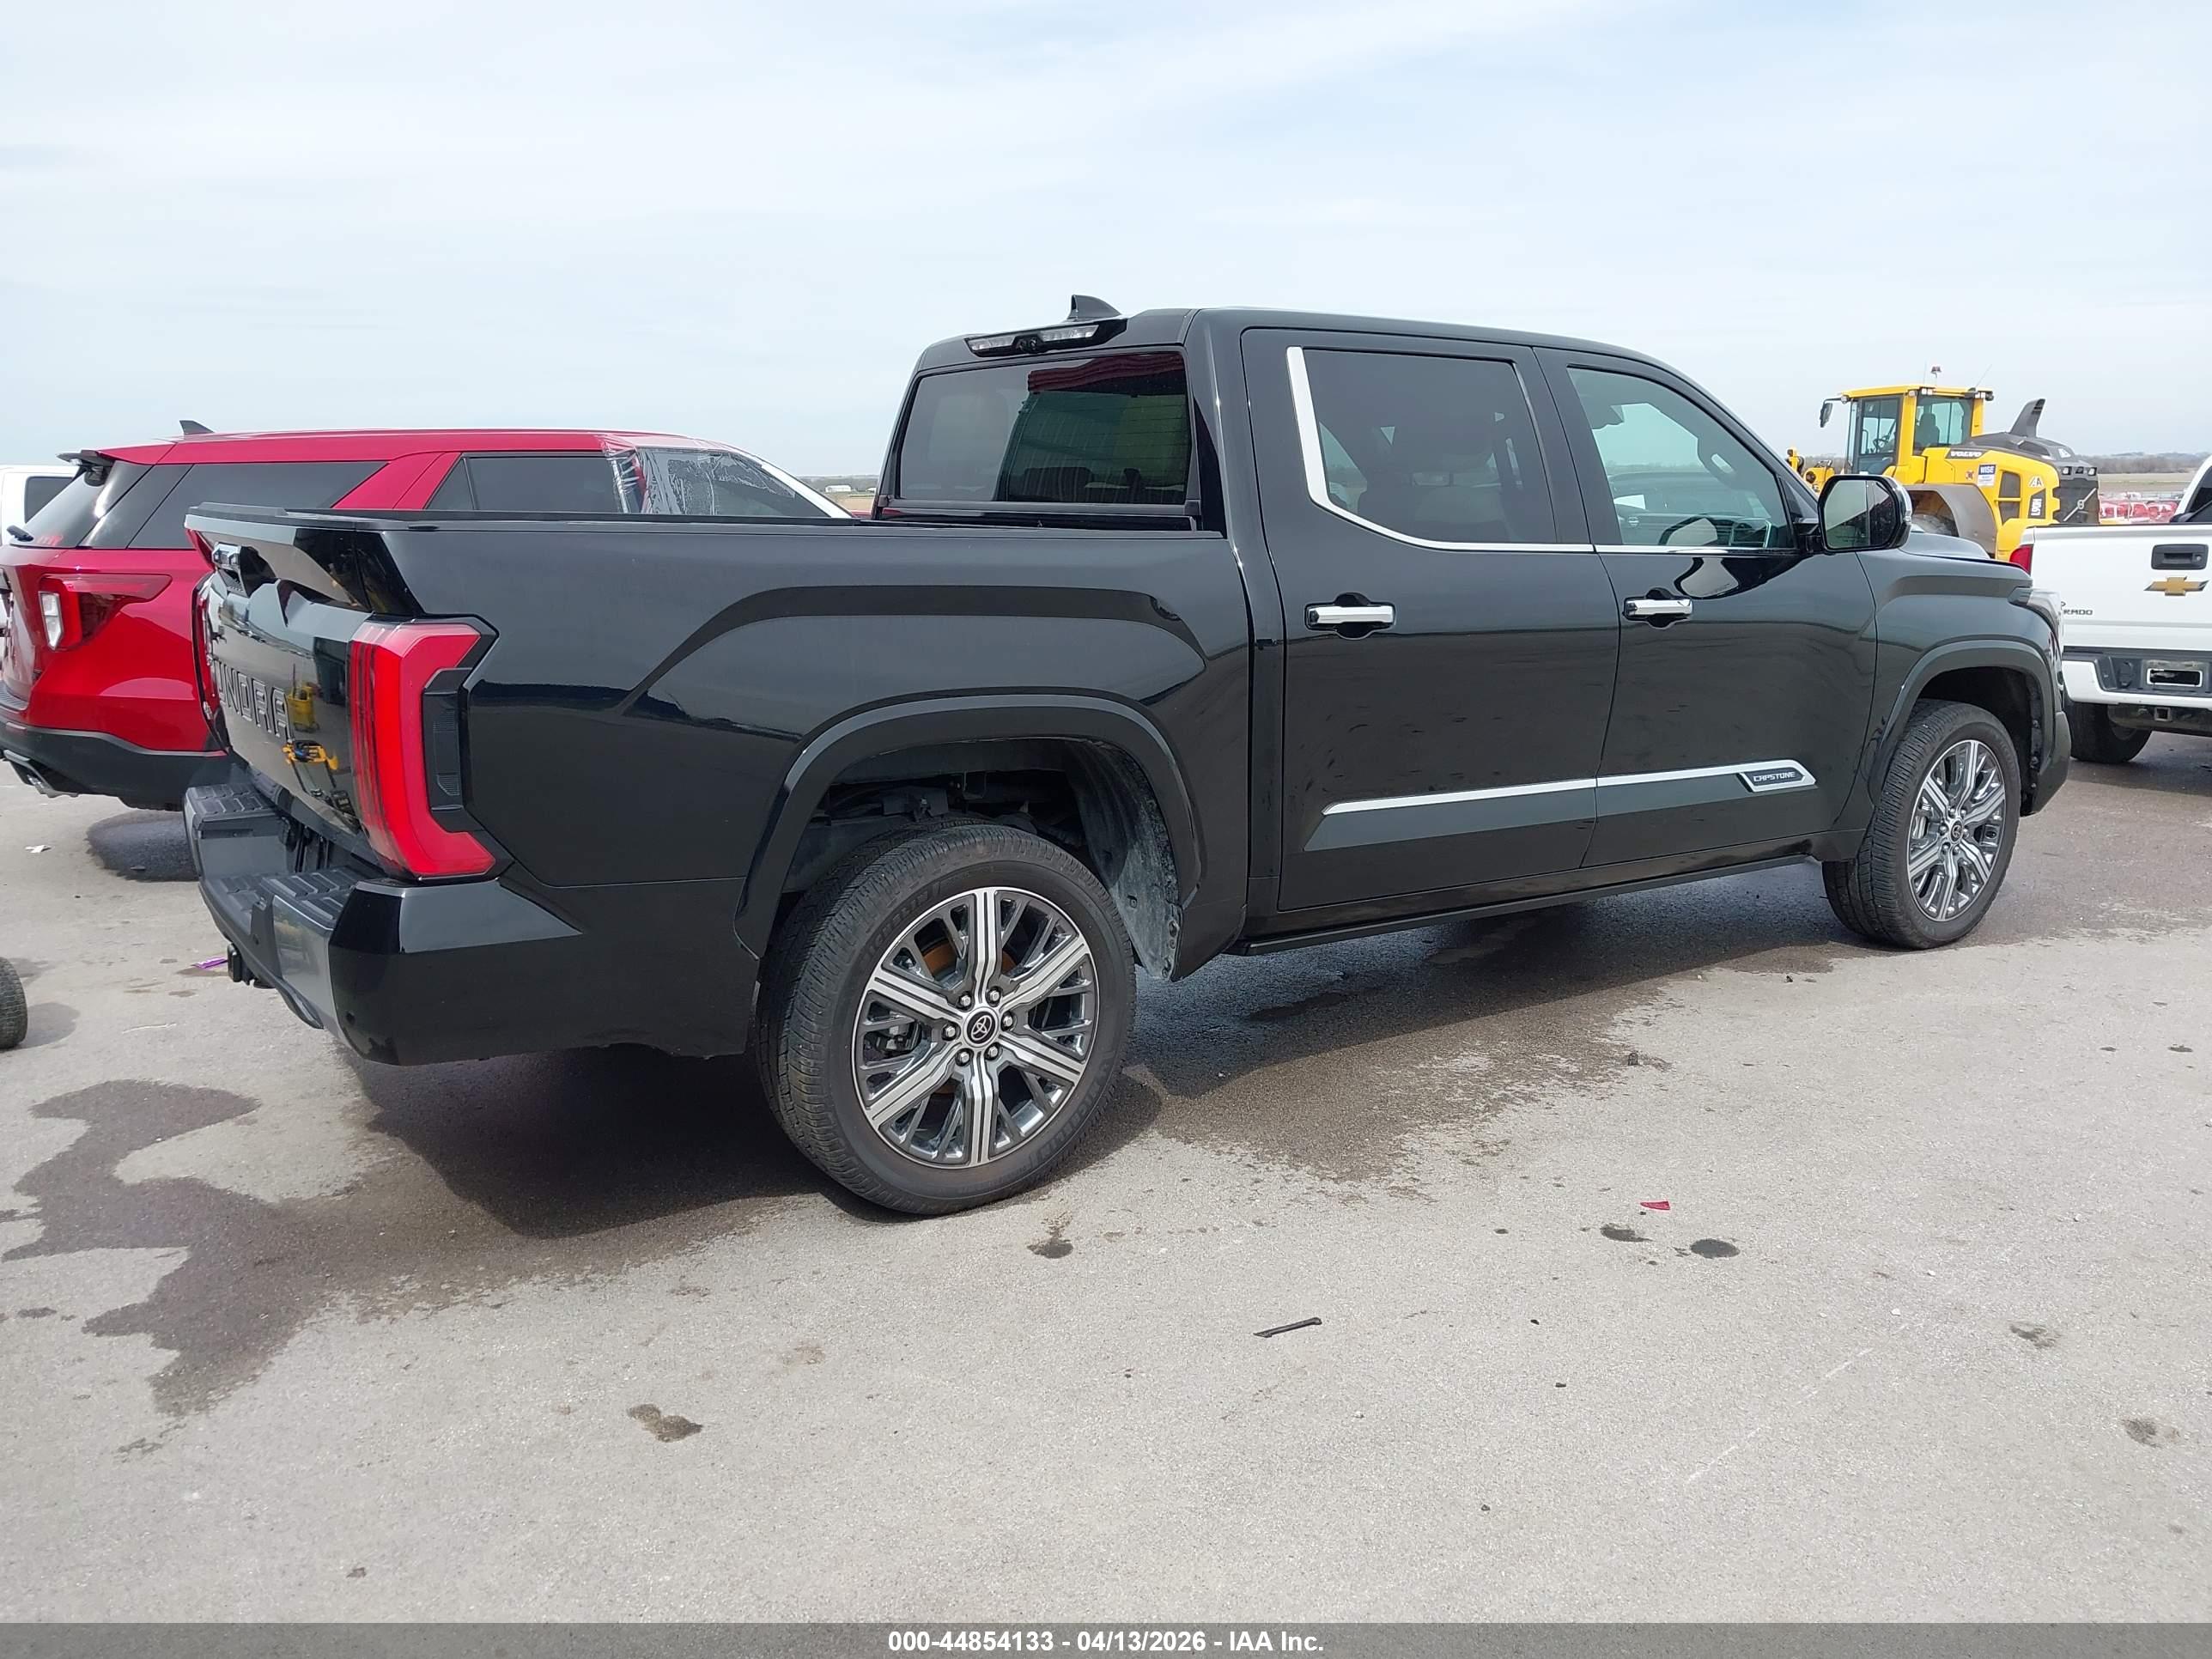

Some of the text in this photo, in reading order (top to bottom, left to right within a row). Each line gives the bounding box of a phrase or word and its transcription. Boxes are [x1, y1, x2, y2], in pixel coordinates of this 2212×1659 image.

[1980, 465, 1995, 474] WISE
[212, 658, 294, 743] UNDRA
[1753, 771, 1796, 782] CAPSTONE
